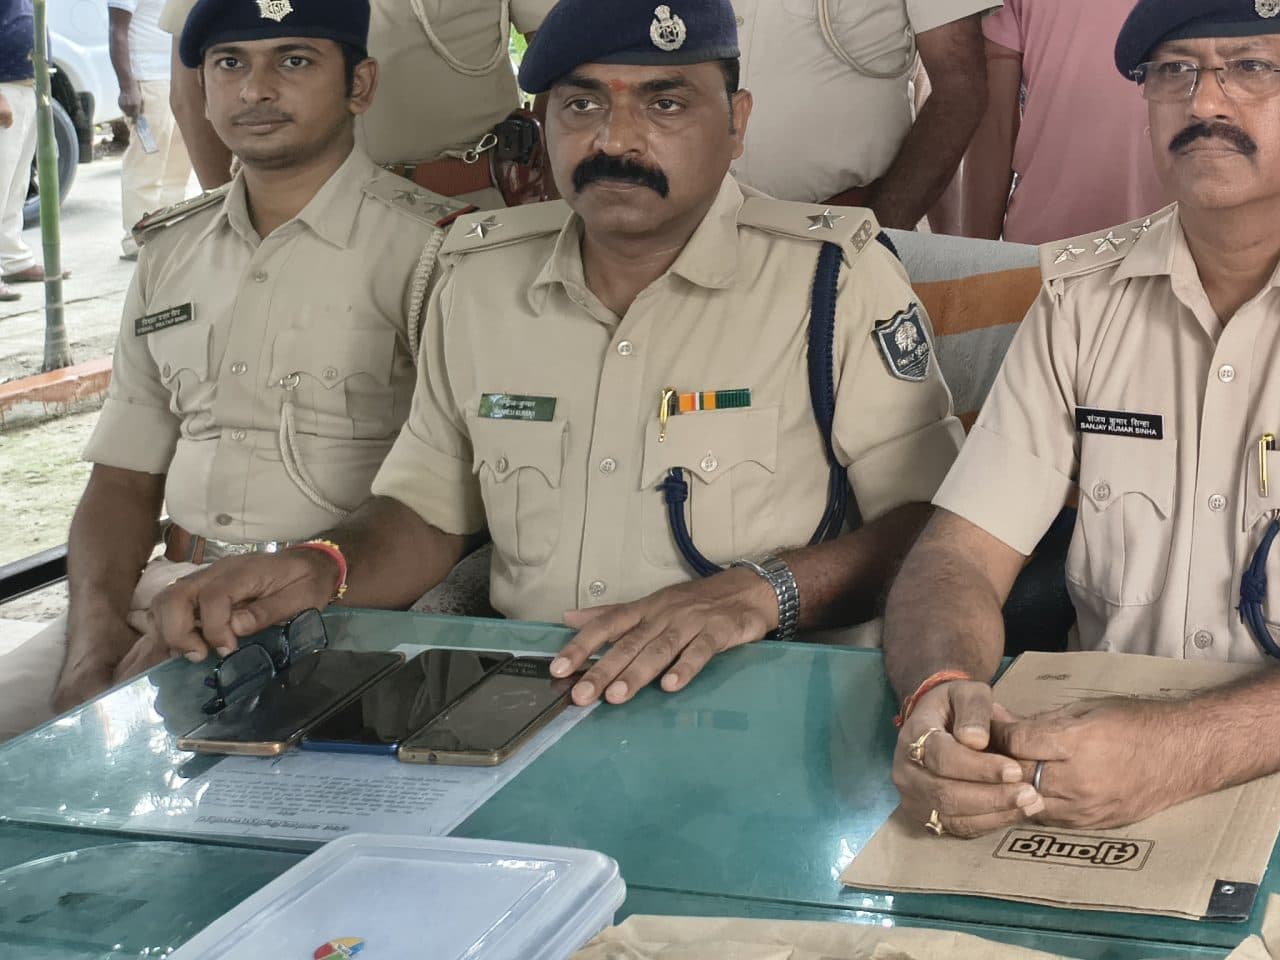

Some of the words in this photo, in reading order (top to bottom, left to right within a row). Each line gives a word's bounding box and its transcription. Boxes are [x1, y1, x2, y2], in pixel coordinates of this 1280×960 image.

[1080, 422, 1107, 431] SANJAY
[1108, 425, 1133, 433] KUMAR
[1135, 428, 1157, 436] SINHA
[1008, 835, 1139, 865] Ajanta
